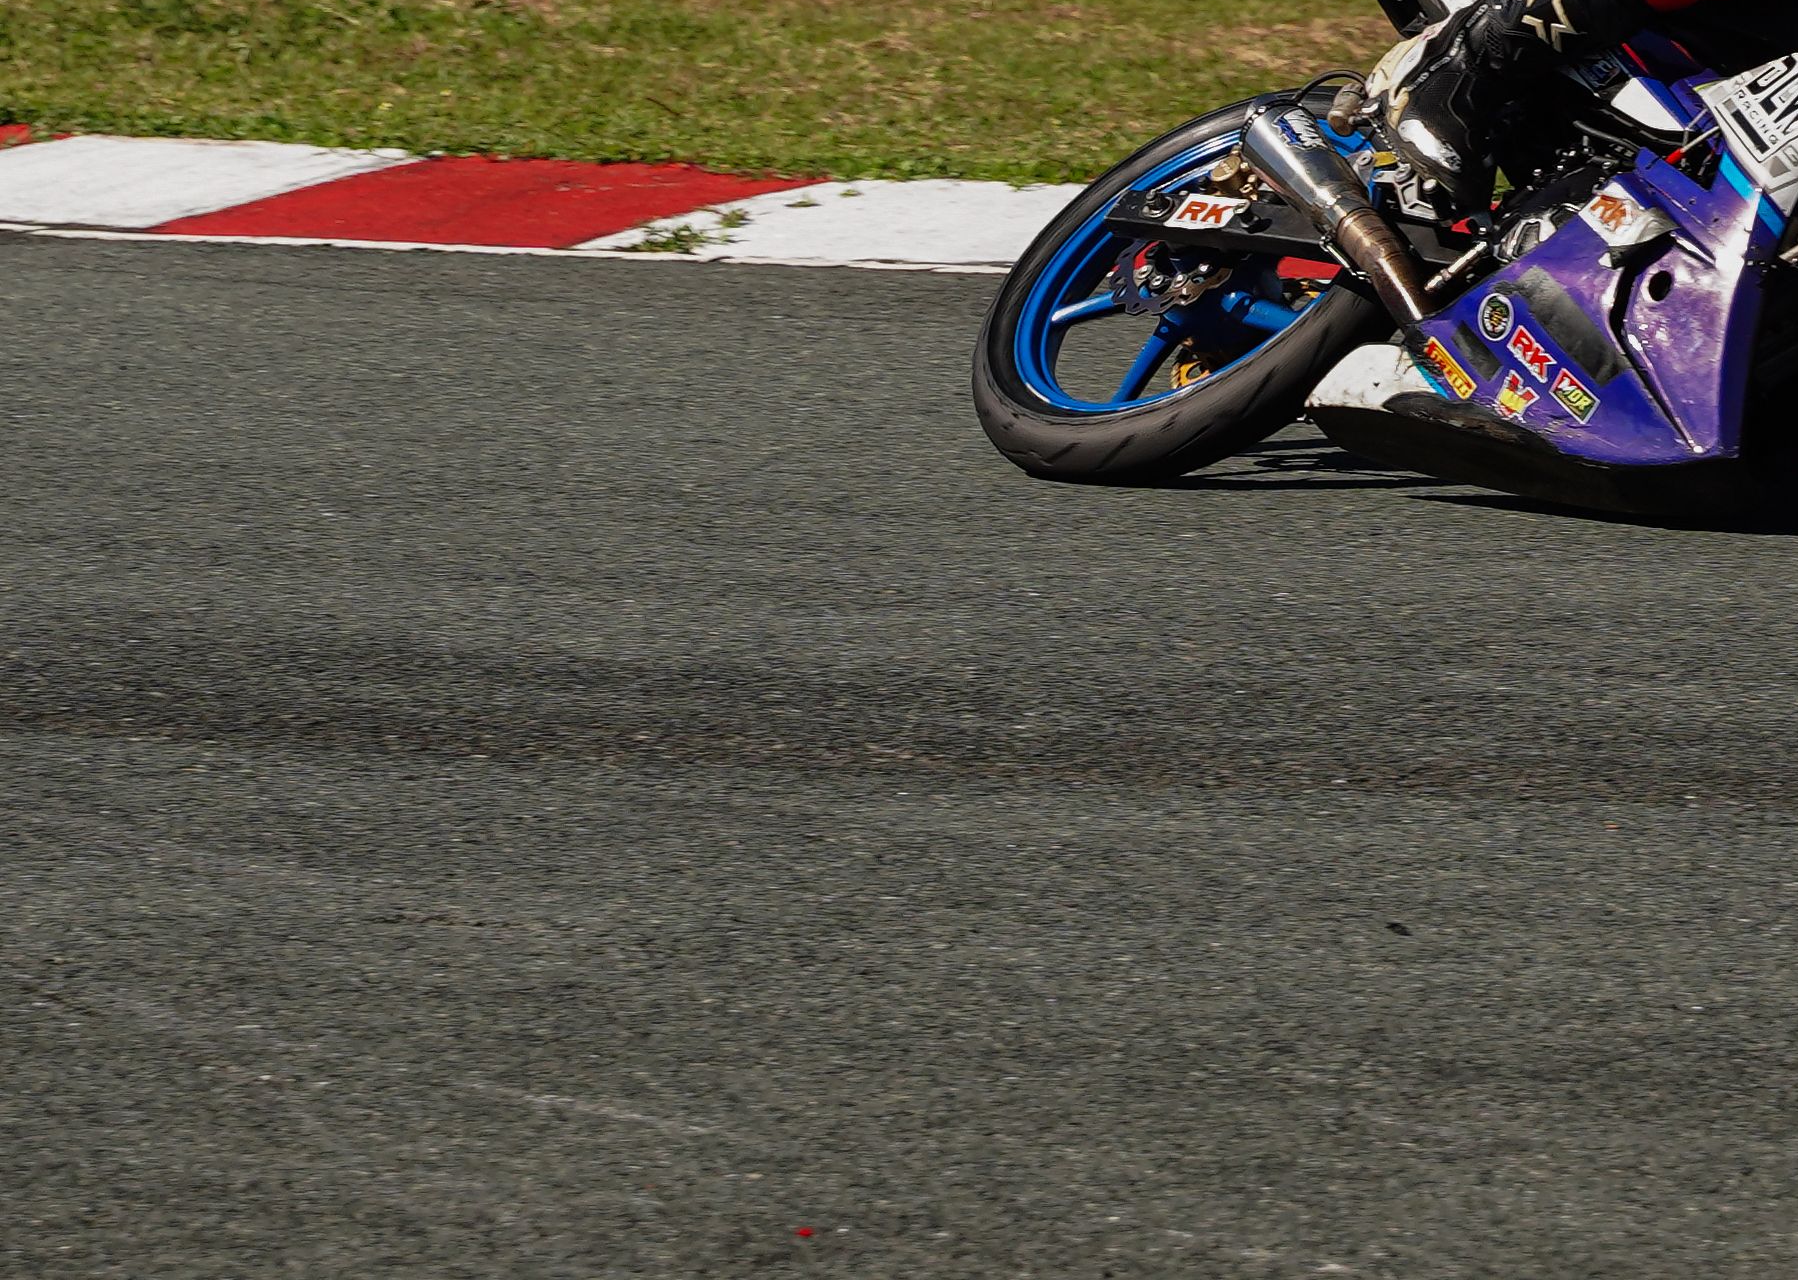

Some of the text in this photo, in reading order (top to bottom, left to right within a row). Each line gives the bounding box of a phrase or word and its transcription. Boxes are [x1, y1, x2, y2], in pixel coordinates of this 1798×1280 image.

[1735, 88, 1780, 146] RACING
[1176, 200, 1233, 225] RK
[1512, 327, 1555, 381] RK
